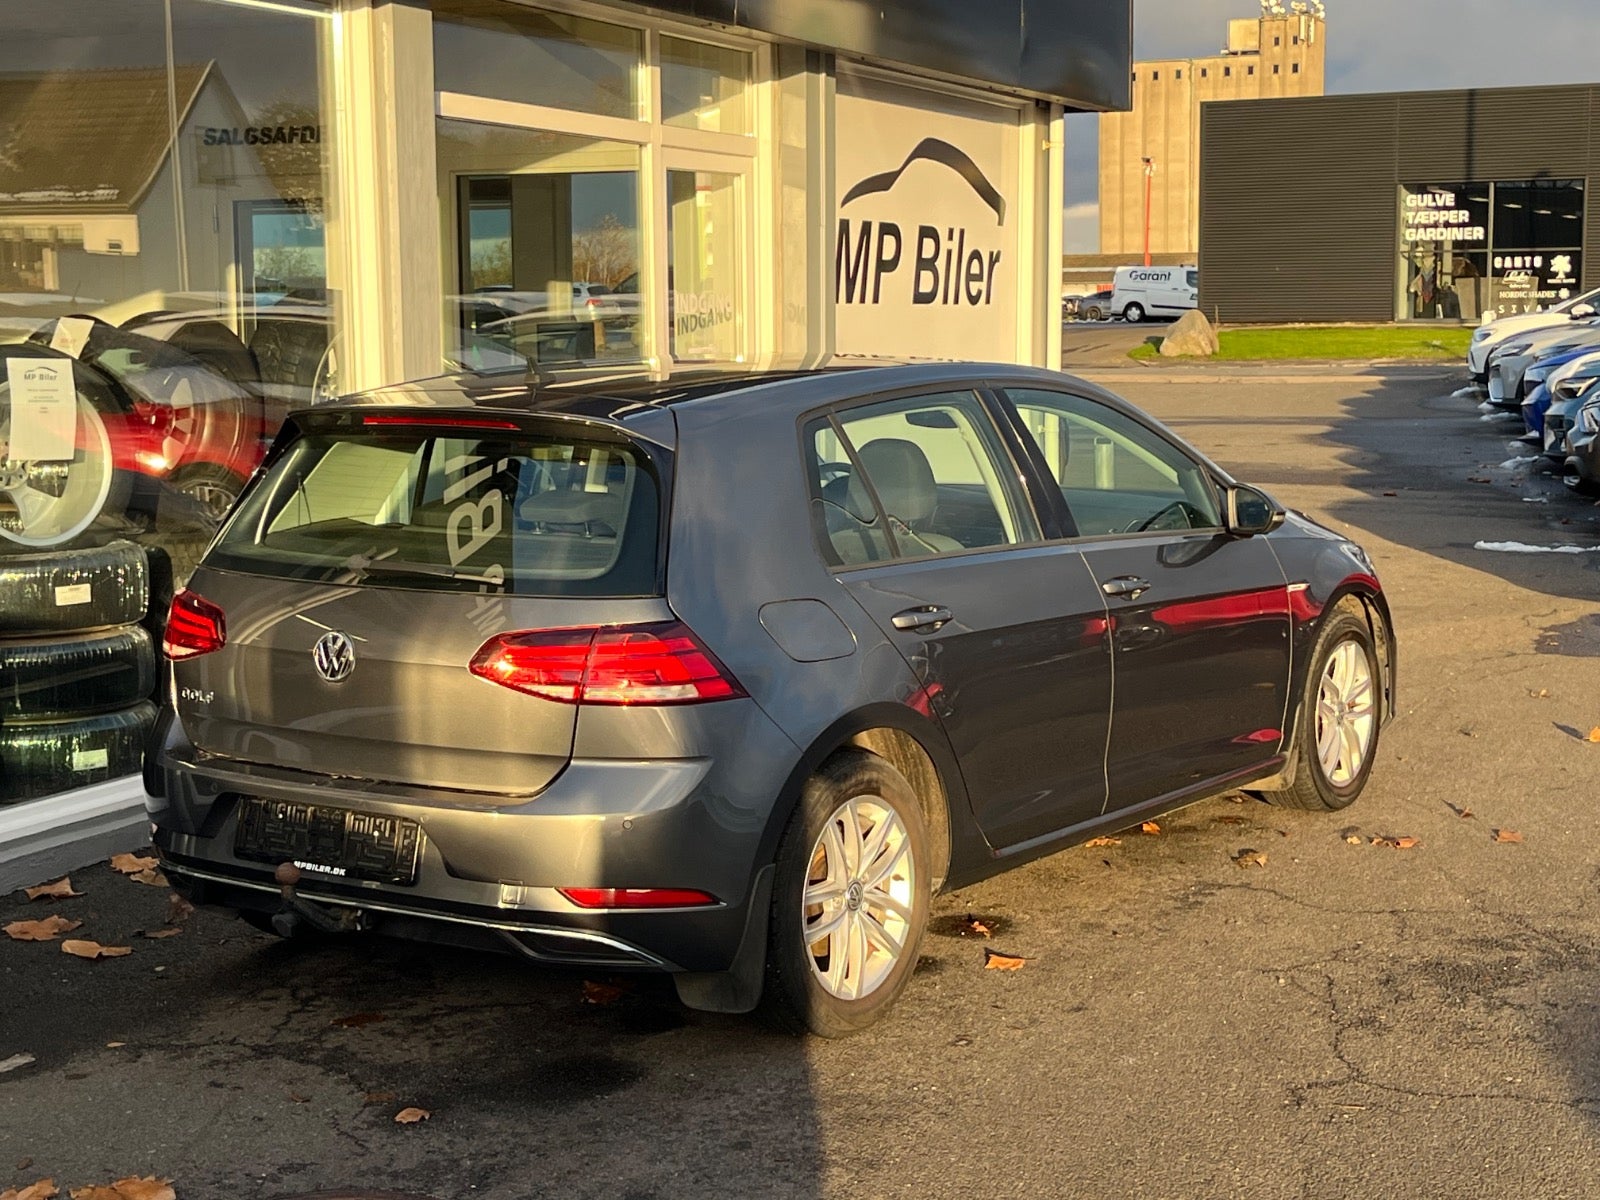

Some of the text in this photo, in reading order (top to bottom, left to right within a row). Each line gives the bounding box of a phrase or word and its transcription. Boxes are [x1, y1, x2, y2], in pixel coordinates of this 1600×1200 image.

[1406, 194, 1456, 207] GULVE
[1406, 210, 1470, 224] TÆPPER
[1405, 227, 1485, 241] GARDINER
[836, 219, 1002, 306] MP Biler
[1129, 271, 1171, 280] Garant
[1499, 290, 1527, 299] NORDIC
